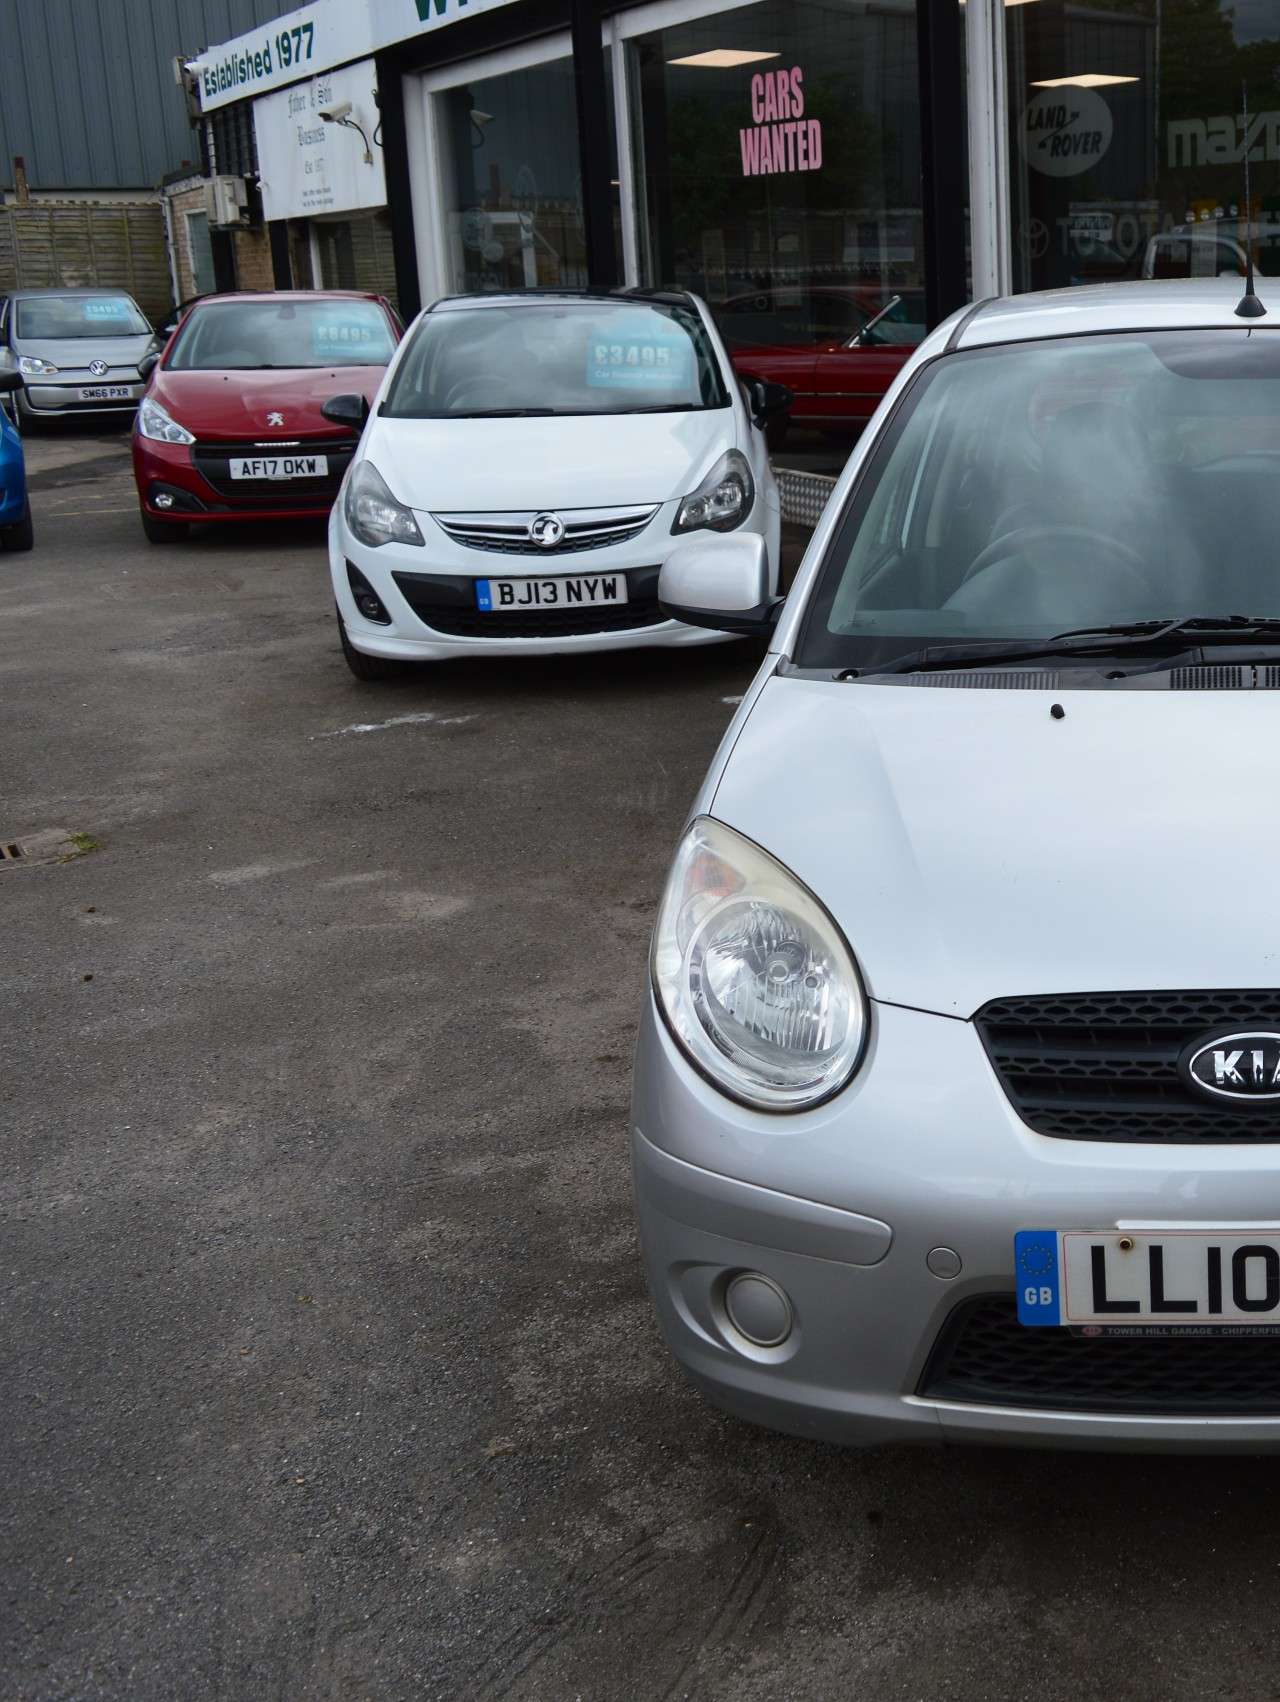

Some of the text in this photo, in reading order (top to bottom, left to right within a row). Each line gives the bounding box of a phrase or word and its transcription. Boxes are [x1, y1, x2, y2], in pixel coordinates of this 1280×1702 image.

[204, 22, 314, 97] Established 1977
[751, 65, 804, 124] CARS
[1026, 104, 1066, 131] LAND
[740, 119, 822, 177] WANTED
[1050, 130, 1101, 157] ROVER
[594, 345, 670, 367] £3495
[110, 386, 129, 397] PXR
[241, 458, 317, 477] AF17 OKW
[498, 574, 618, 606] BJ13 NYW
[1024, 1286, 1053, 1305] GB
[1107, 1327, 1143, 1337] TOWER
[1146, 1327, 1168, 1337] HILL
[1171, 1326, 1214, 1337] GARAGE
